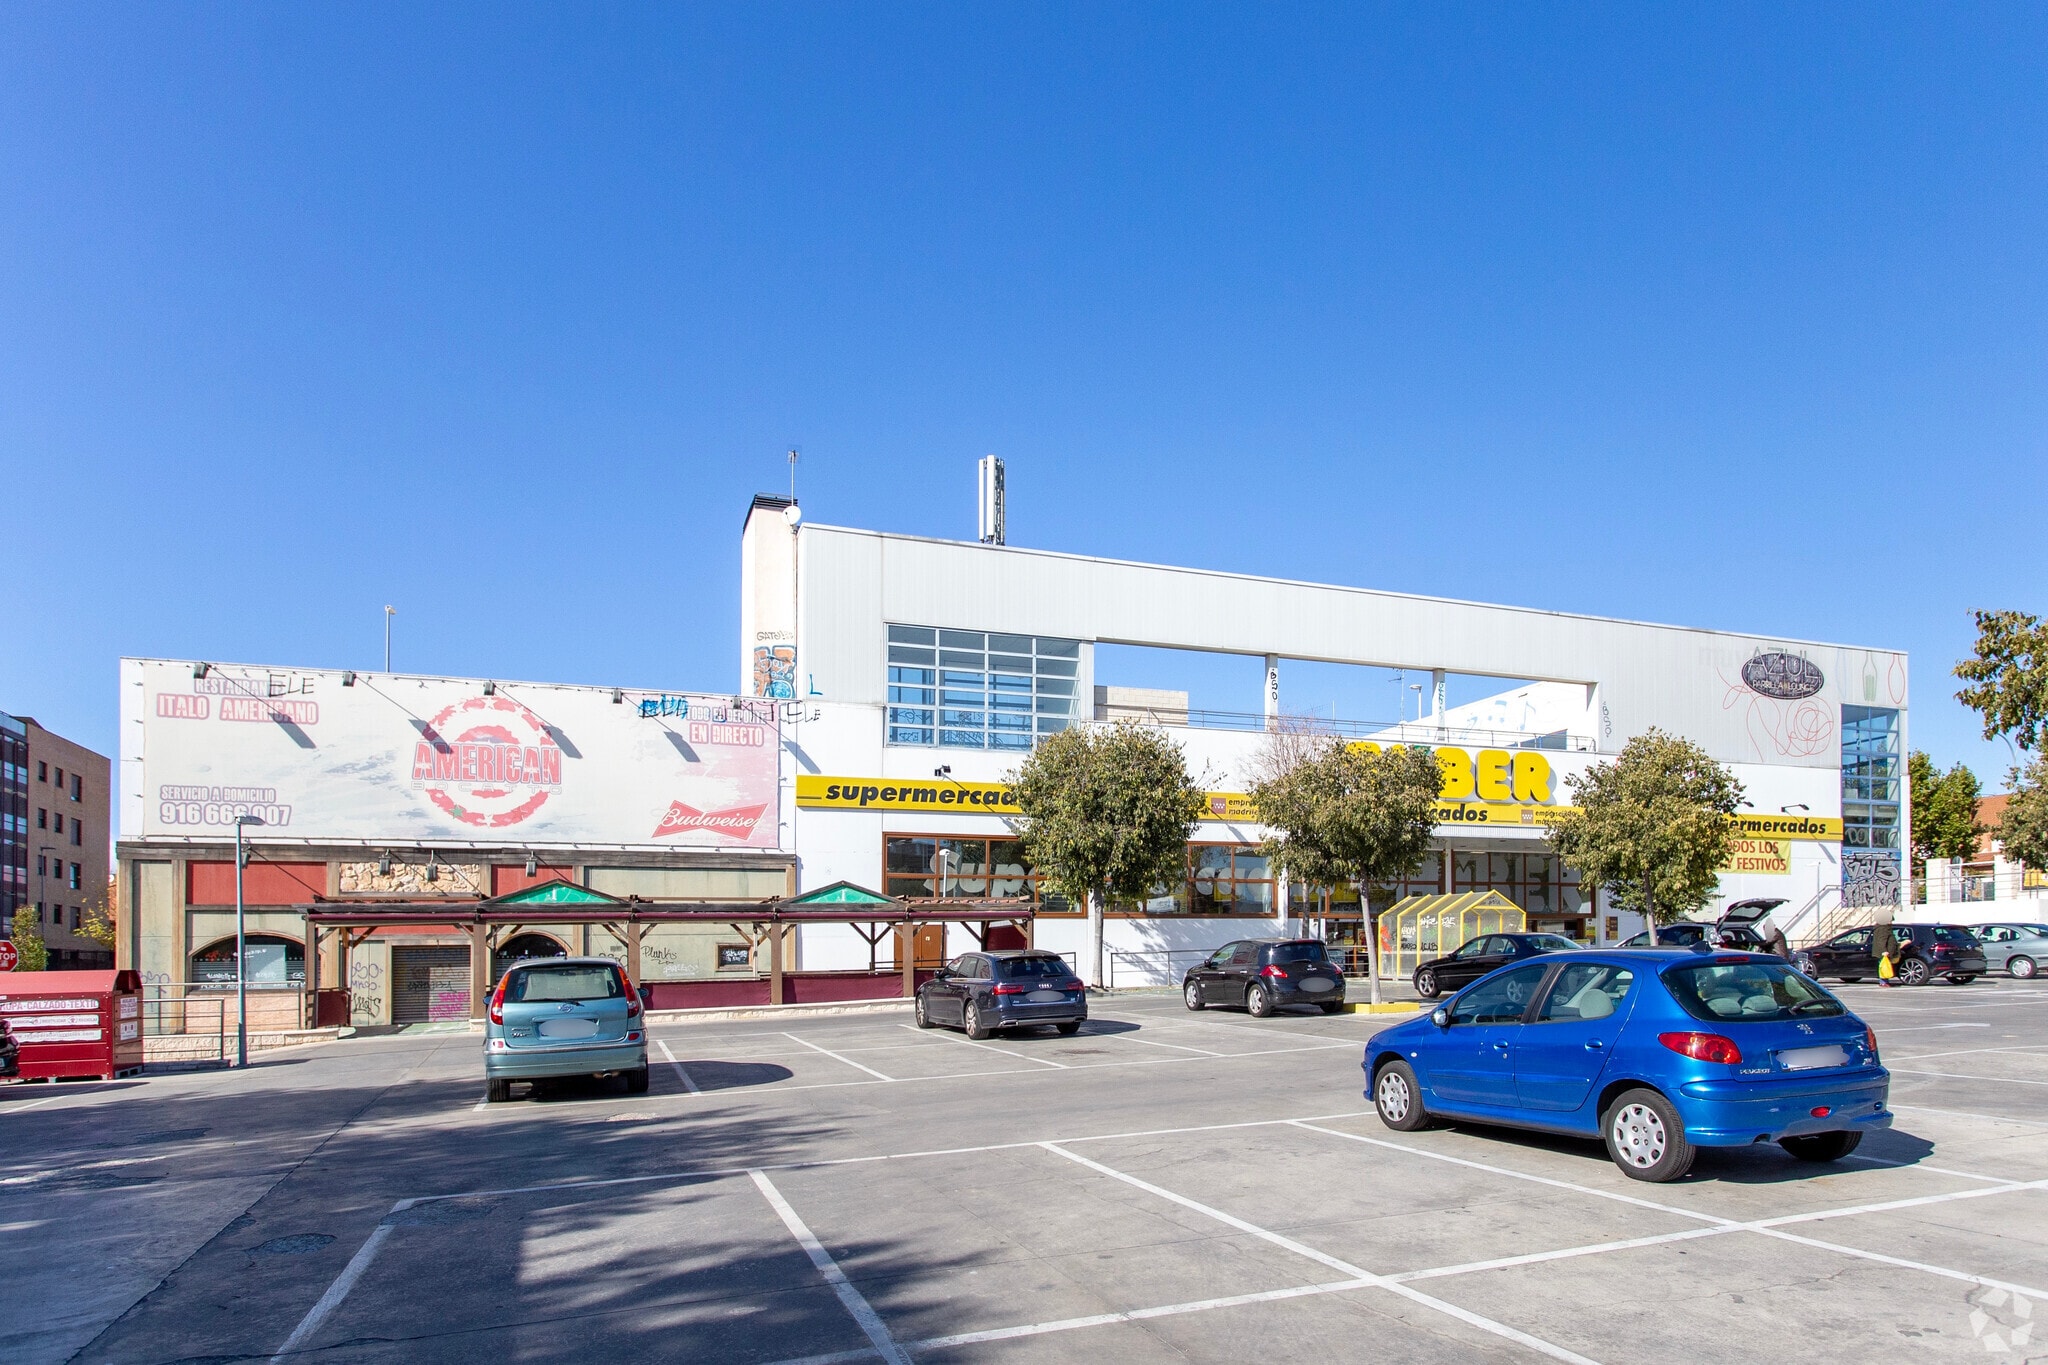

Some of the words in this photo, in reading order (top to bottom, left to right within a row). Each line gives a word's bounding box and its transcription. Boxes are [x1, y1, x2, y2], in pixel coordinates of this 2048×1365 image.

[1747, 646, 1820, 680] AZUL
[158, 694, 209, 719] ITALO
[220, 698, 318, 724] AMERICANO
[690, 723, 708, 744] EN
[711, 724, 764, 747] DIRECTO
[412, 742, 561, 785] AMERICAN
[161, 785, 209, 801] SERVICIO
[211, 786, 221, 802] A
[223, 787, 276, 803] DOMICILIO
[161, 802, 202, 825] 916
[661, 808, 761, 828] Budweiser
[1759, 841, 1779, 855] LOS
[1737, 857, 1787, 872] FESTIVOS
[27, 1000, 67, 1010] CALZADO
[70, 999, 98, 1009] TEXTIL
